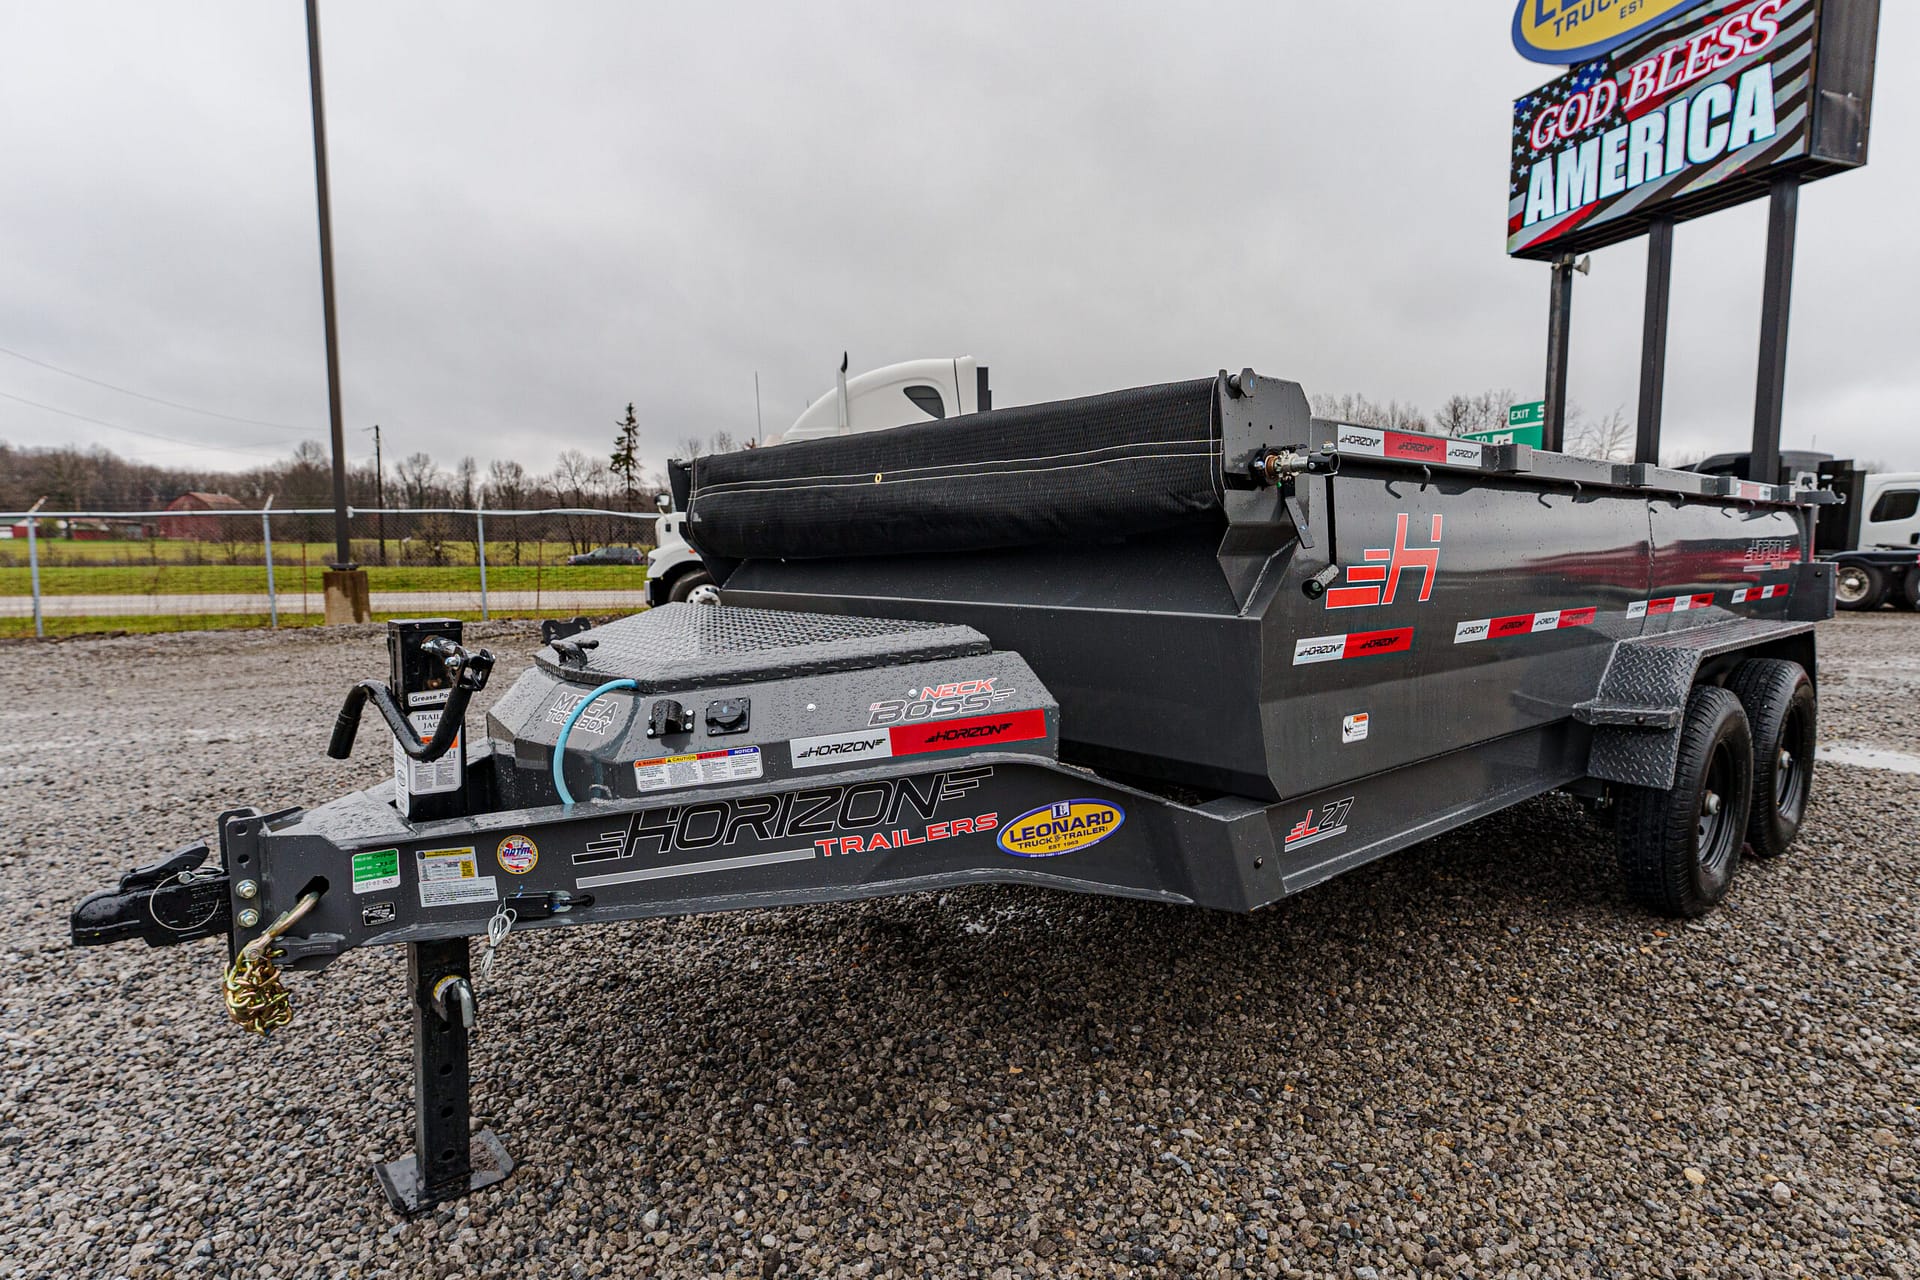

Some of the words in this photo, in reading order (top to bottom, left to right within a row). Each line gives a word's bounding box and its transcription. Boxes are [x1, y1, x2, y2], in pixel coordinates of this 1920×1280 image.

[1553, 0, 1618, 37] TRUC
[1530, 76, 1618, 150] GOD
[1621, 2, 1786, 110] BLESS
[1522, 62, 1777, 228] AMERICA
[1511, 408, 1530, 420] EXIT
[1344, 433, 1381, 447] HORIZON
[1400, 441, 1435, 453] HORIZON
[1449, 448, 1480, 459] HORIZON
[1459, 624, 1489, 636] HORIZON
[1301, 643, 1344, 656] HORIZON
[920, 678, 998, 700] NECK
[416, 713, 441, 721] TRAIL
[868, 688, 1014, 726] BOSS
[424, 723, 438, 731] JAC
[545, 709, 611, 735] TOOBOX
[807, 738, 886, 757] HORIZON
[931, 723, 1012, 743] HORIZON
[672, 755, 696, 763] CAUTION
[620, 768, 990, 857] HORIZON
[815, 812, 998, 856] TRAILERS
[1009, 810, 1115, 843] LEONARD
[1017, 836, 1053, 850] TRUCK
[1062, 825, 1105, 840] TRAILER
